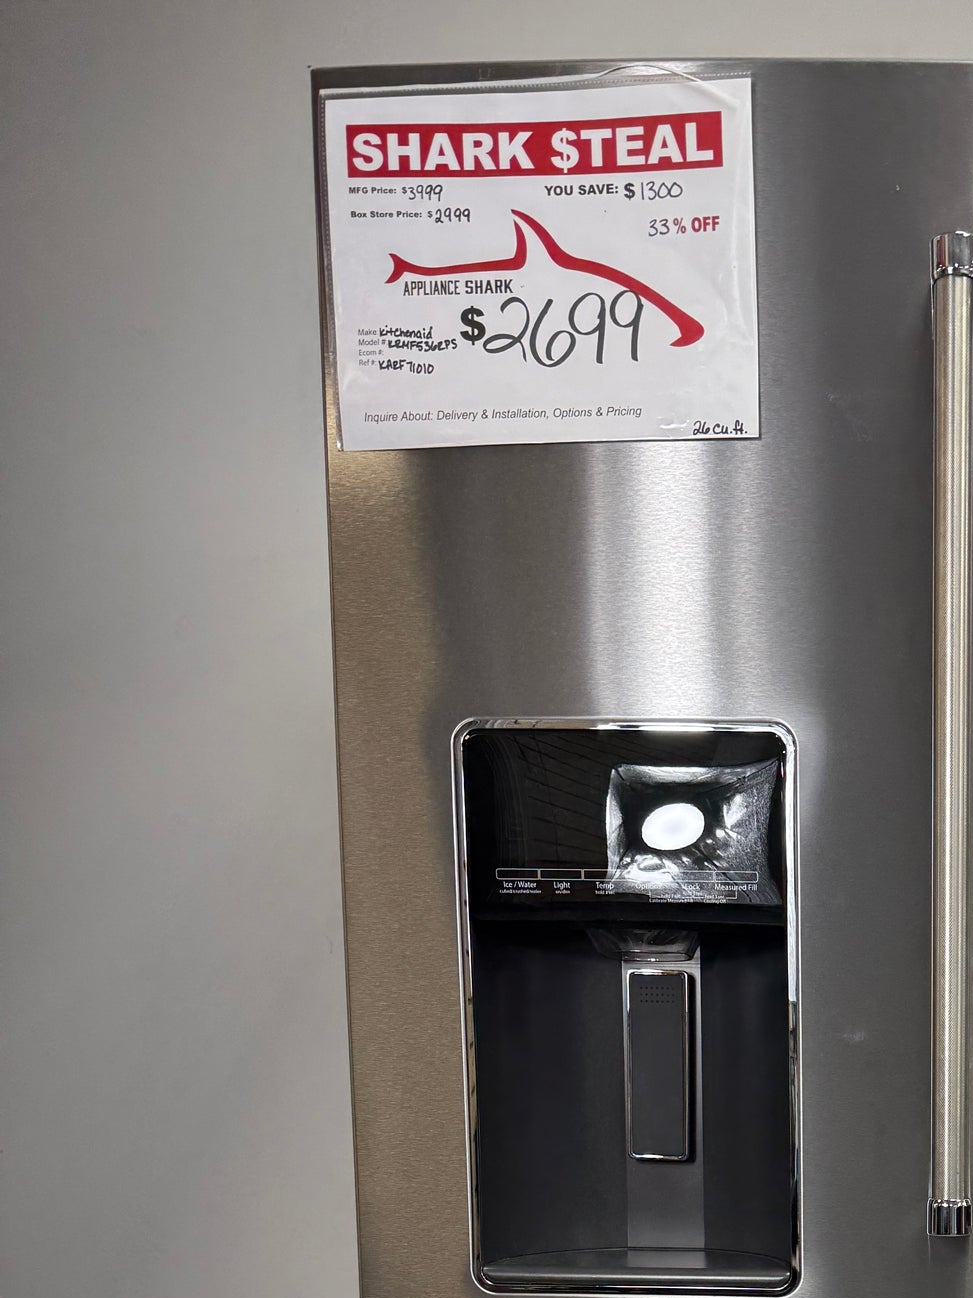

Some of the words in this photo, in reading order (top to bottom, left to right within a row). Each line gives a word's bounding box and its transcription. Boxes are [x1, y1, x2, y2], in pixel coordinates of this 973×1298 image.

[352, 131, 535, 172] SHARK
[550, 122, 714, 173] $TEAL
[348, 187, 368, 195] MFG
[371, 187, 397, 195] Price:
[544, 185, 574, 197] YOU
[578, 183, 619, 196] SAVE:
[350, 210, 367, 218] Box
[370, 210, 394, 218] Store
[396, 210, 422, 218] Price:
[691, 216, 720, 233] OFF
[403, 280, 461, 297] APPLIANCE
[465, 279, 513, 295] SHARK
[358, 338, 380, 346] Model
[359, 349, 377, 357] Ecom
[359, 359, 370, 367] Ref
[364, 410, 398, 425] Inquire
[400, 410, 433, 422] About:
[436, 409, 478, 422] Delivery
[481, 409, 489, 419] &
[491, 407, 549, 420] Installation,
[553, 407, 593, 420] Options
[595, 406, 603, 417] &
[606, 406, 642, 418] Pricing
[693, 420, 710, 436] 26
[553, 882, 571, 890] Light
[595, 882, 615, 891] Temp
[714, 883, 747, 891] Measured
[748, 883, 758, 891] Fill
